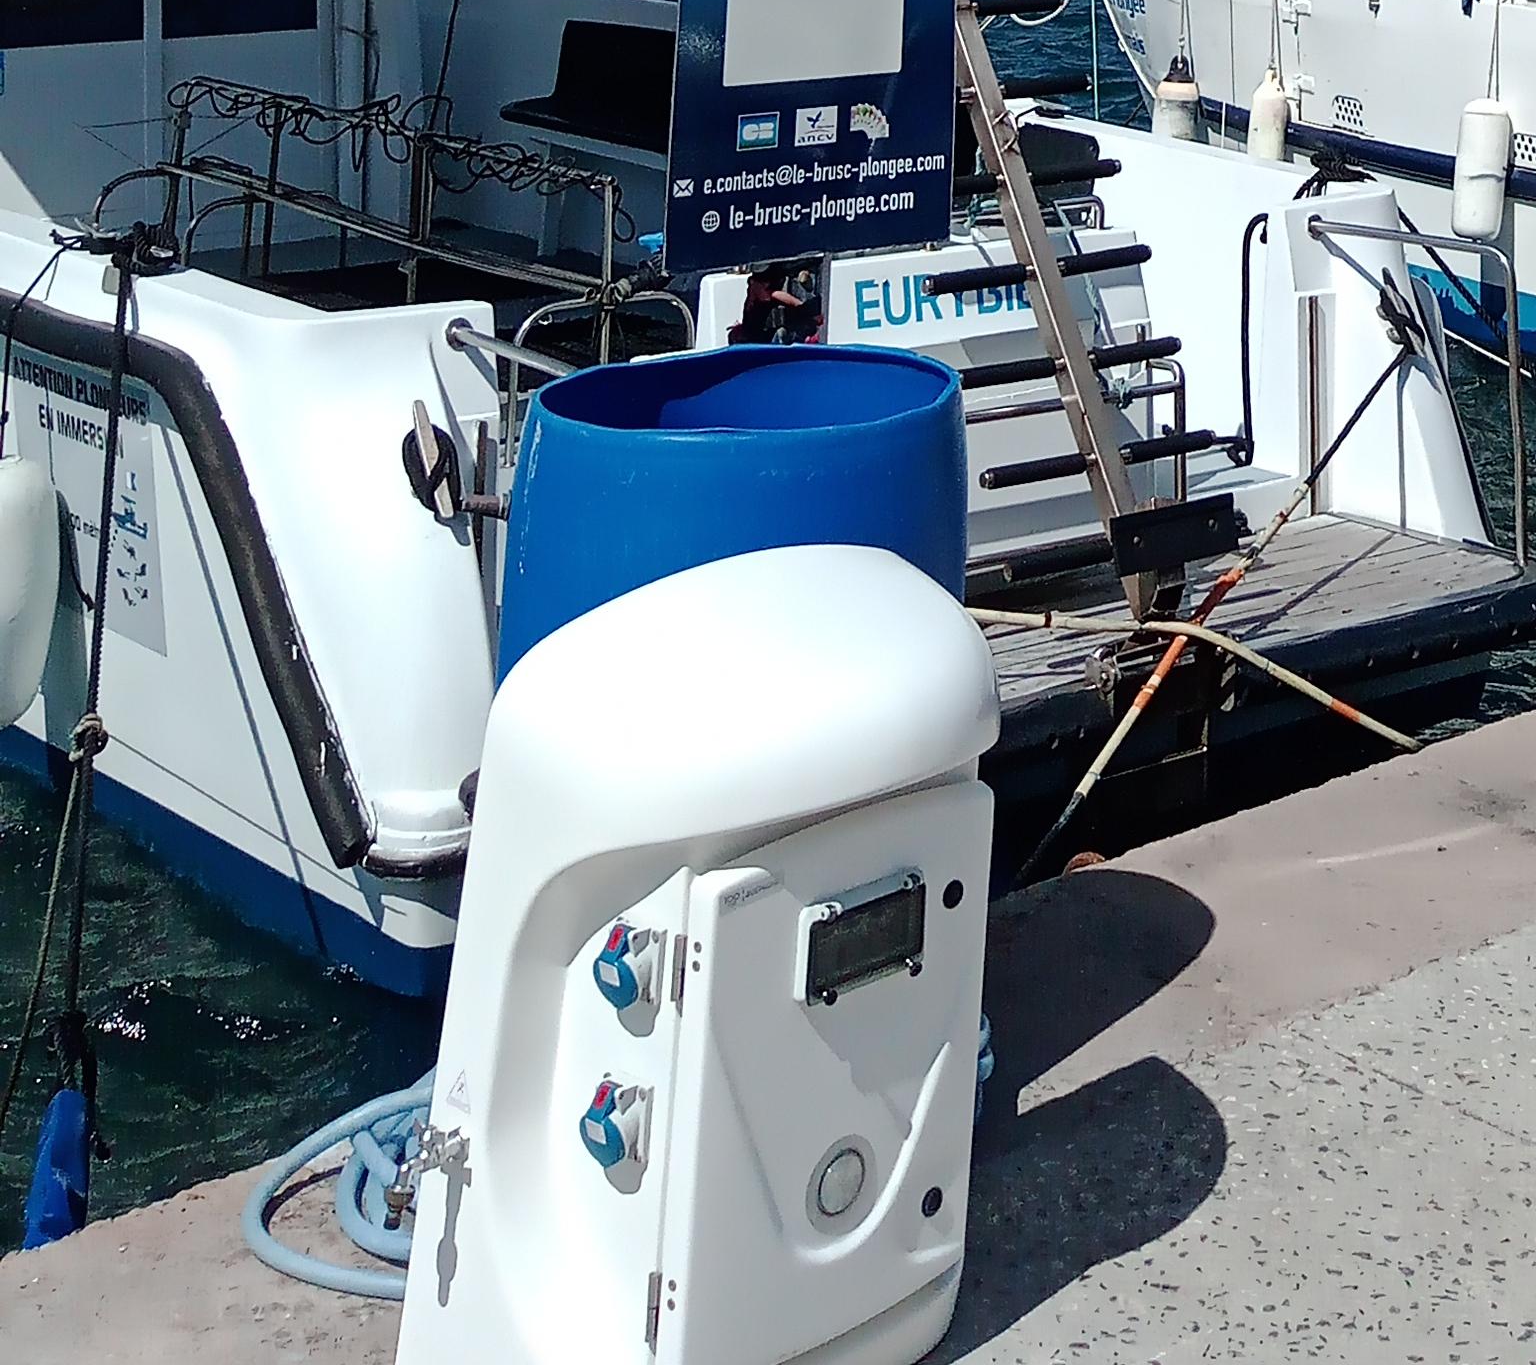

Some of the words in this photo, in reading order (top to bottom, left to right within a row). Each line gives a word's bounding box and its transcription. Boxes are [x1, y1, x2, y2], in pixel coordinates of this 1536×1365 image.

[703, 154, 946, 195] e.contacts@le-brusc-plongee.com
[729, 191, 915, 230] le-brusc-plongee.com
[12, 356, 73, 399] ATTENTION
[38, 404, 54, 431] EN
